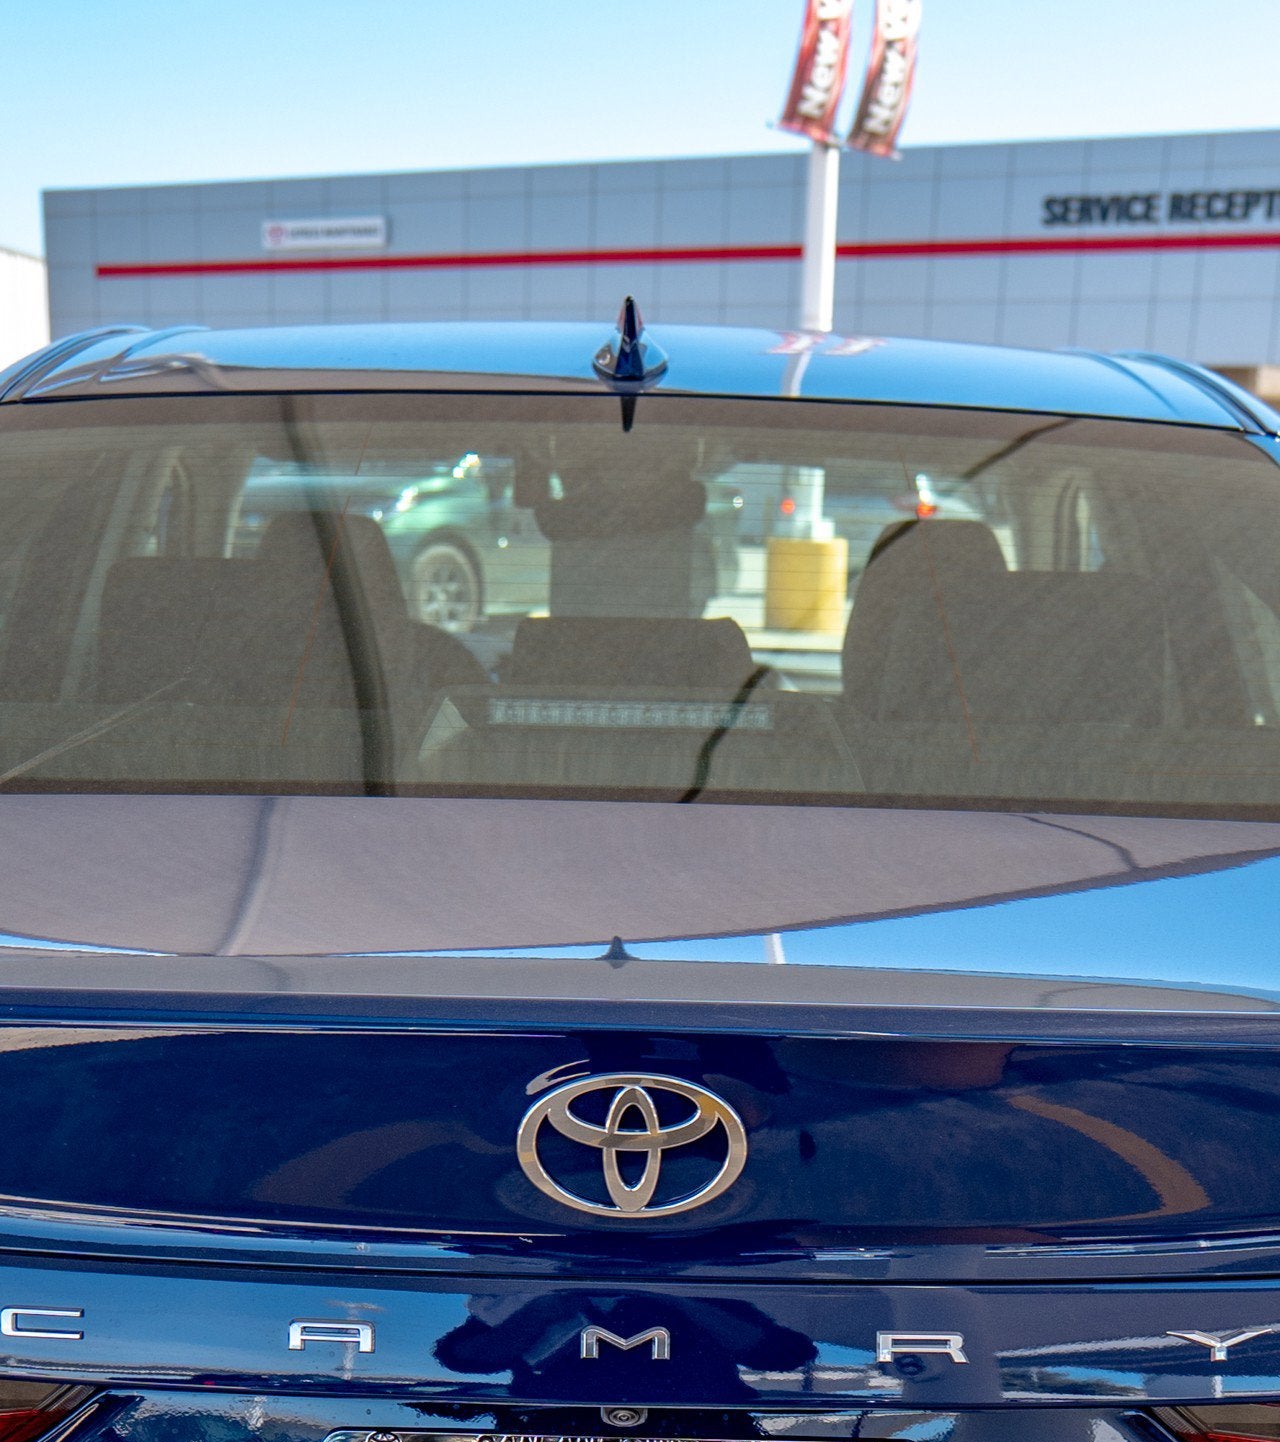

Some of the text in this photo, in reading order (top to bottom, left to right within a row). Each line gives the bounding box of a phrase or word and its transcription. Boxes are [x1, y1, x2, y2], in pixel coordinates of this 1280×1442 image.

[797, 28, 841, 119] New
[863, 47, 907, 135] New
[1042, 194, 1160, 225] SERVICE
[0, 1305, 1272, 1364] CAMRY
